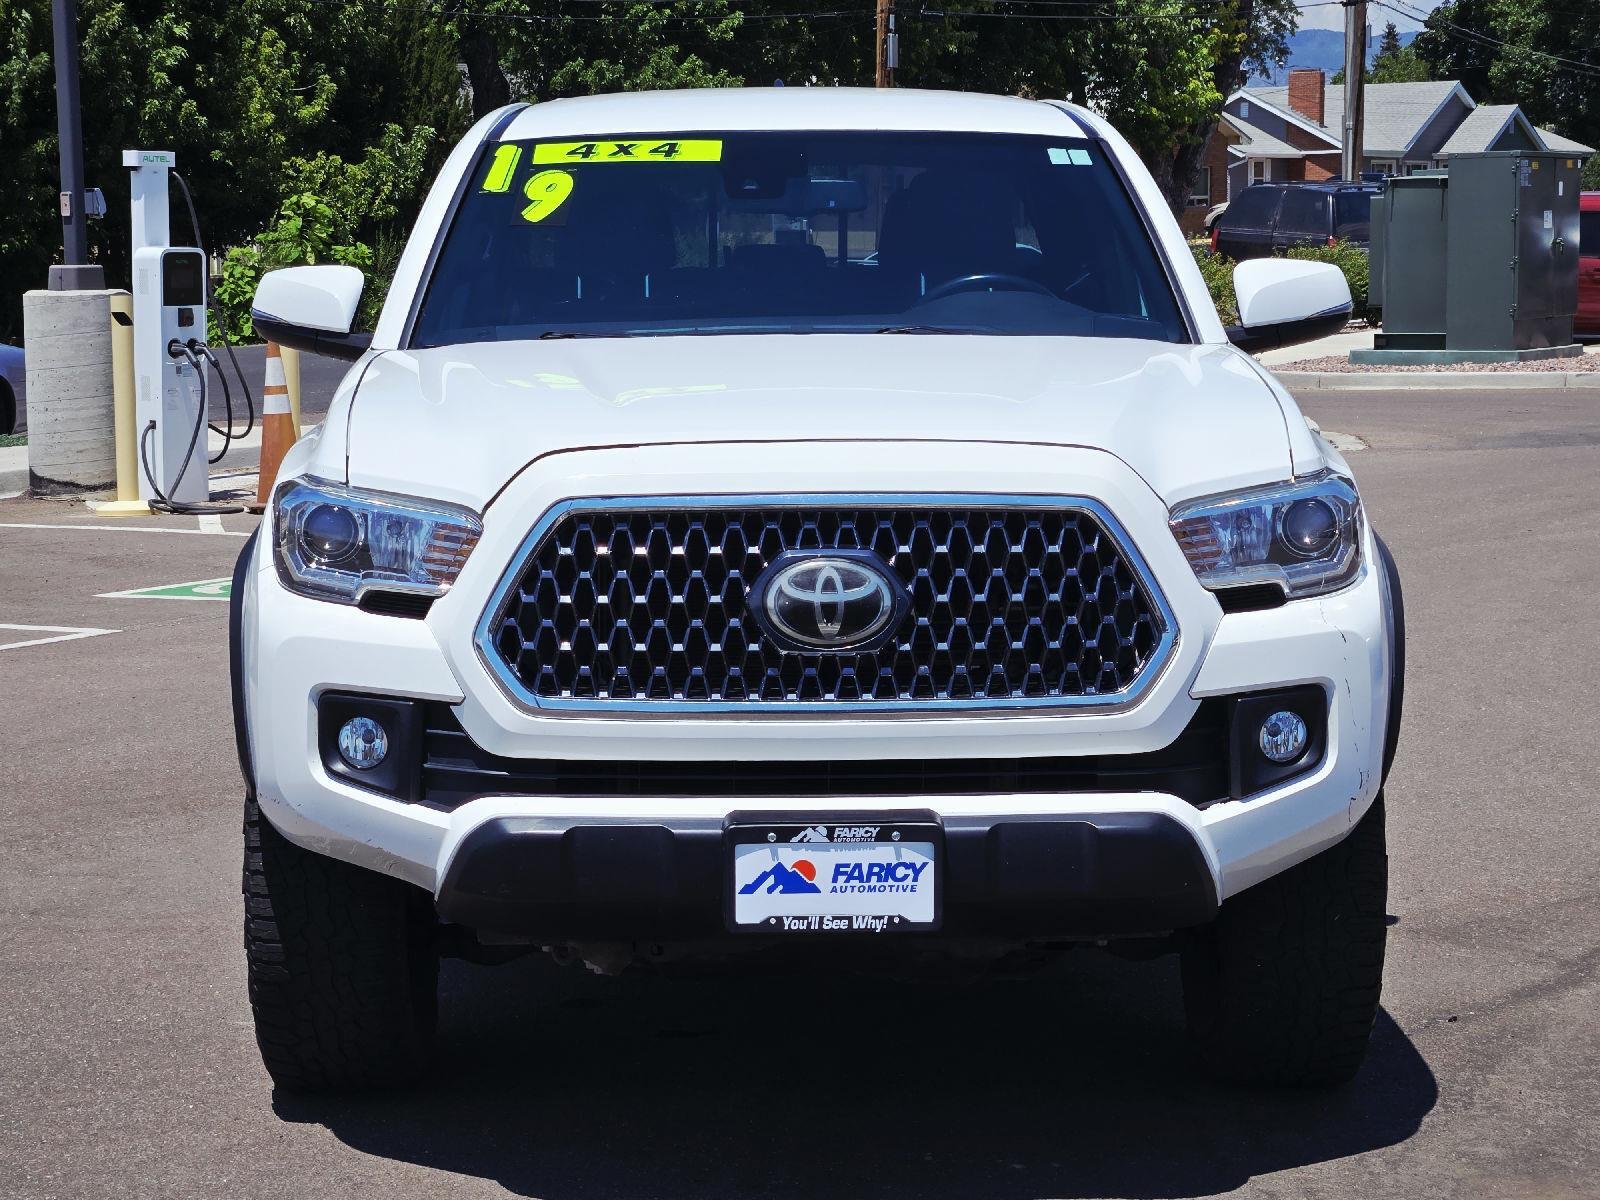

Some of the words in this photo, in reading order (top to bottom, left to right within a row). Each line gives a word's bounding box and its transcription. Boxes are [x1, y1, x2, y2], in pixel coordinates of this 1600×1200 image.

[142, 155, 171, 163] AUTEL
[833, 826, 881, 838] FARICY
[831, 861, 930, 884] FARICY
[830, 884, 918, 893] AUTOMOTIVE
[783, 916, 820, 930] You'll
[822, 915, 849, 930] See
[852, 915, 889, 933] Why!
